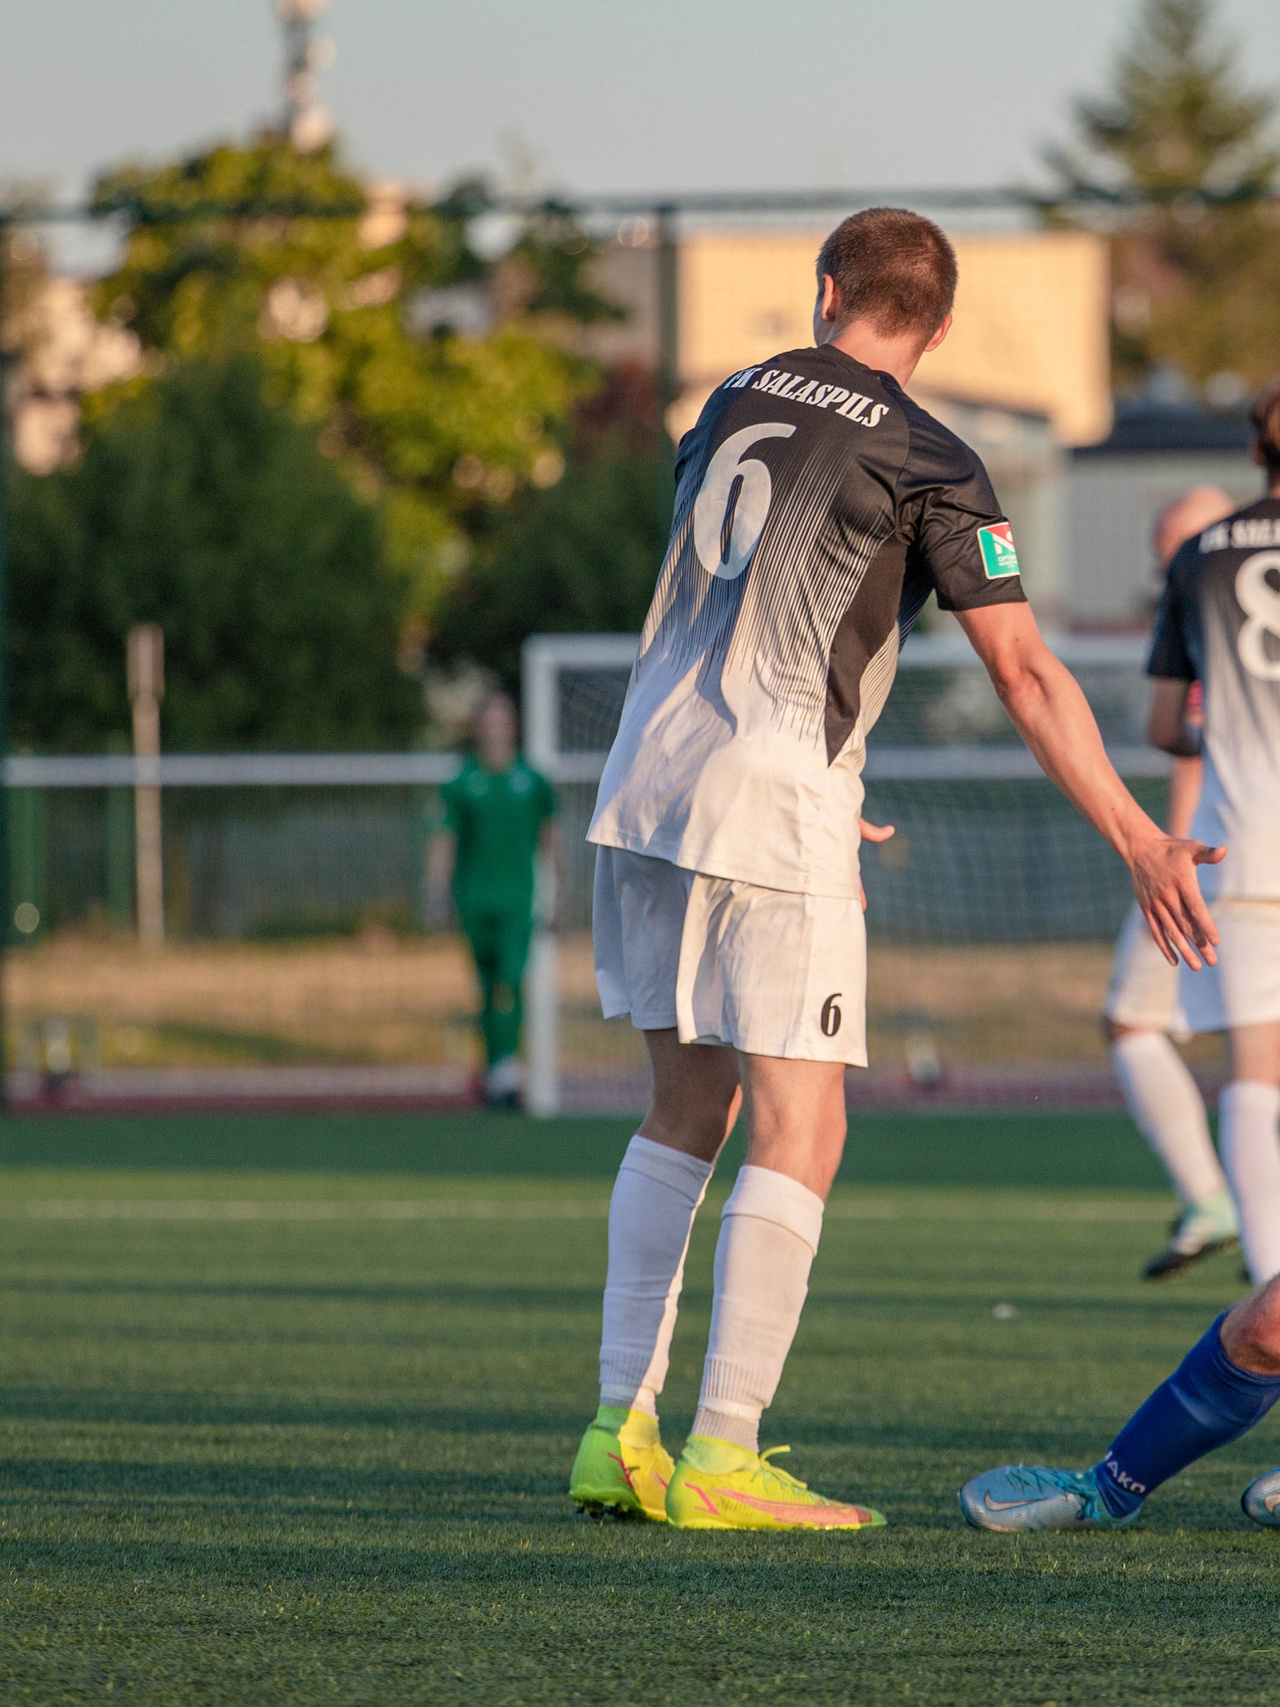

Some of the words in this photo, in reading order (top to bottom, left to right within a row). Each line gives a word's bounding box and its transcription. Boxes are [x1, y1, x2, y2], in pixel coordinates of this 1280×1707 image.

[751, 369, 890, 428] SALASPILS
[694, 422, 797, 580] 6
[820, 993, 842, 1037] 6
